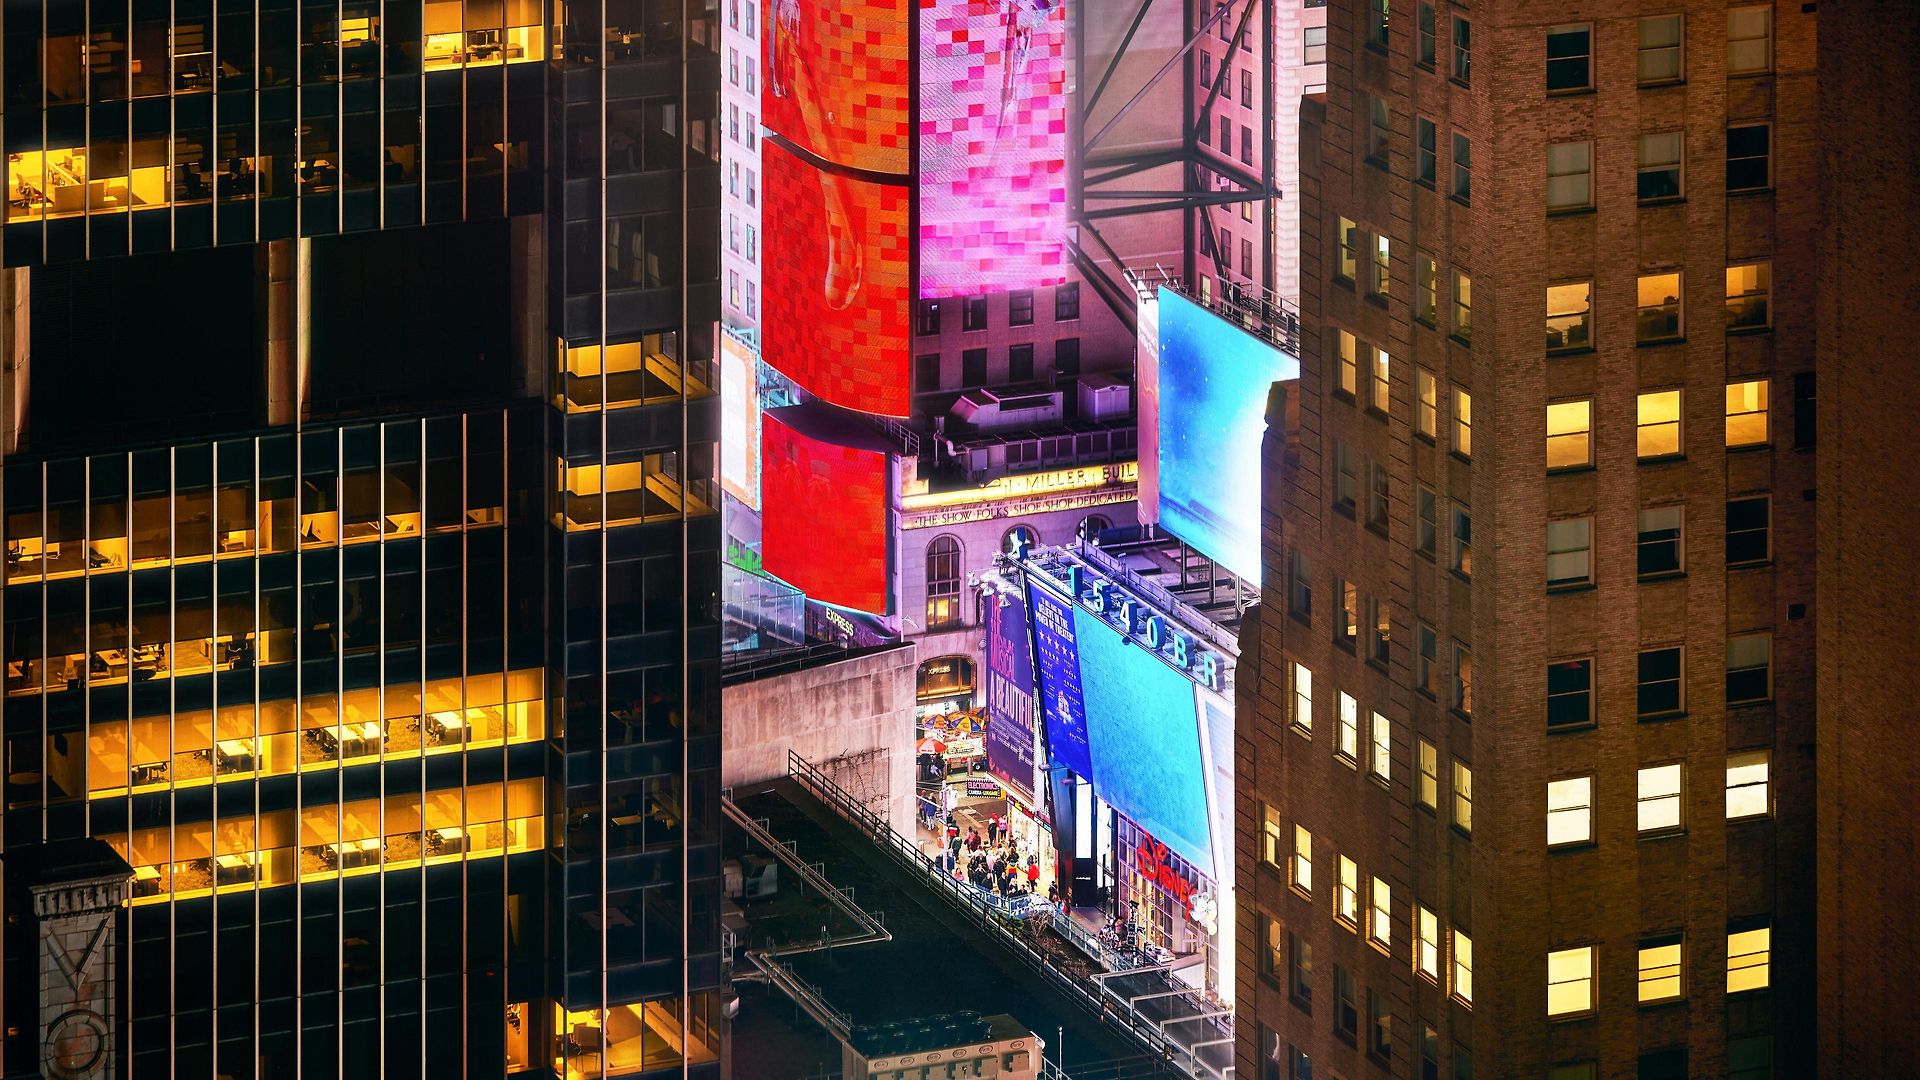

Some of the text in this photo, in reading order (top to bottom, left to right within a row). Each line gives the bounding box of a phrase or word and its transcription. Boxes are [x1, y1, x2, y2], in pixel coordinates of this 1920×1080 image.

[1026, 469, 1085, 490] MILLER
[918, 513, 938, 525] THE
[942, 510, 972, 523] SHOW
[1014, 502, 1041, 515] SHOE
[1045, 498, 1072, 511] SHOP
[1076, 491, 1132, 507] DEDICATED
[826, 606, 854, 636] EXPRESS
[968, 781, 998, 790] ELECTRONICS
